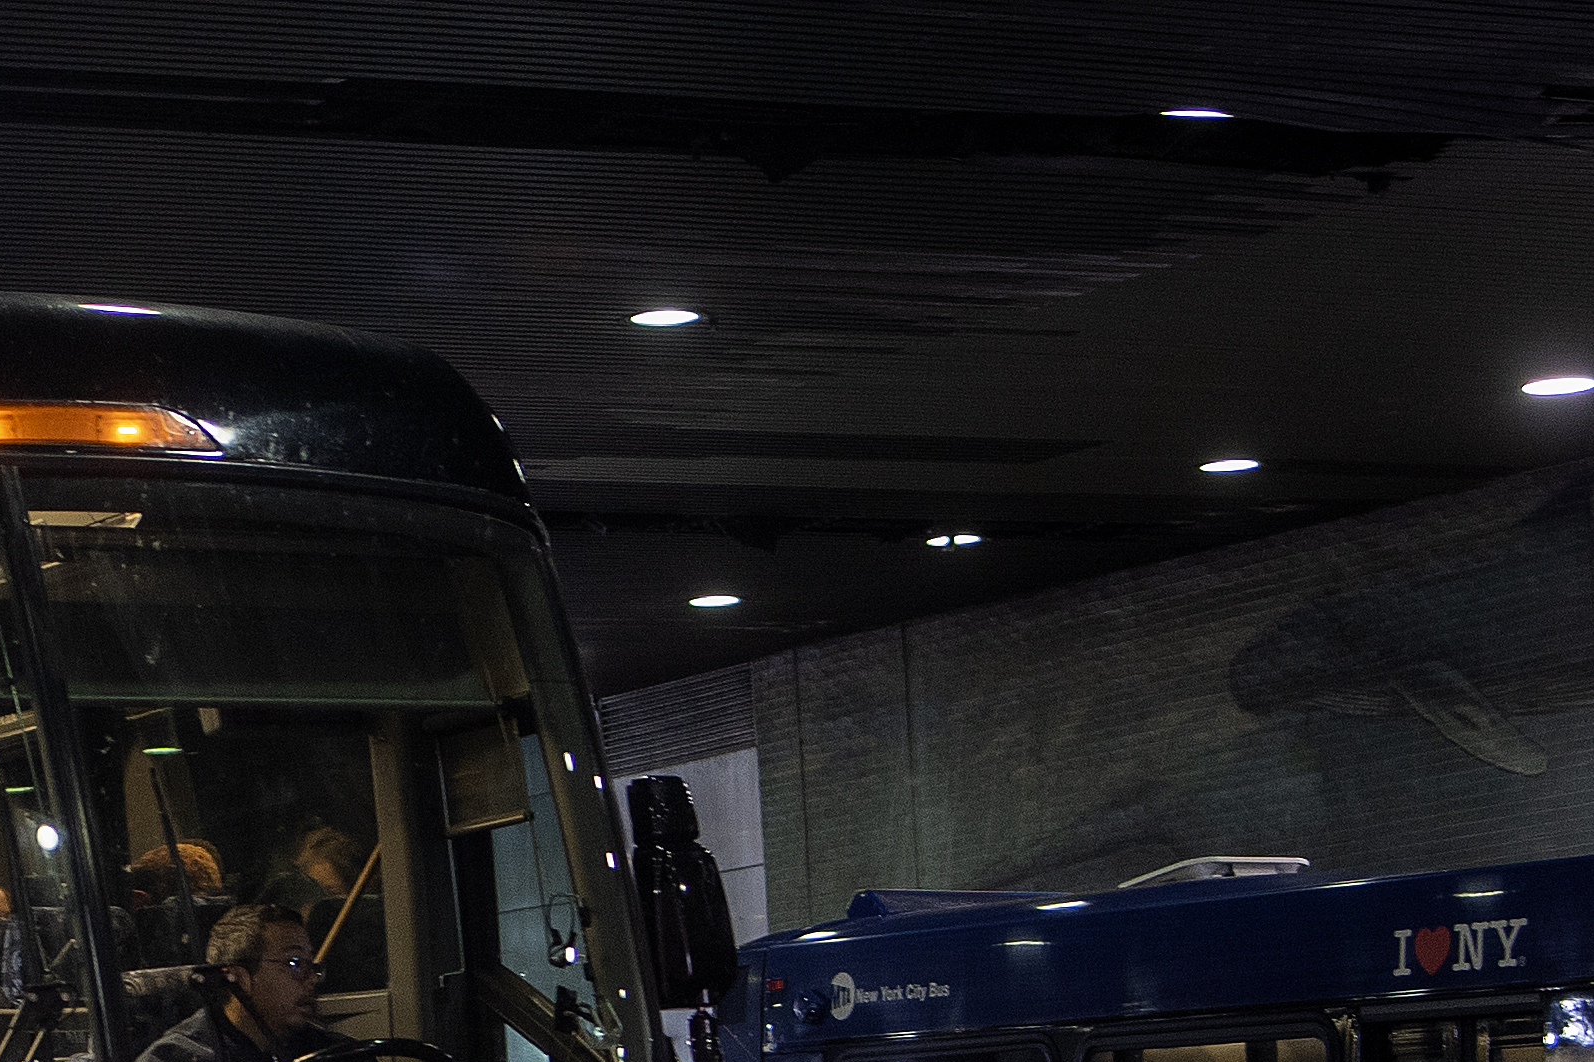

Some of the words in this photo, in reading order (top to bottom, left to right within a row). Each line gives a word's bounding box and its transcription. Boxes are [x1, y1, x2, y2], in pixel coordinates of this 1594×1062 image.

[1392, 929, 1412, 976] I
[1452, 917, 1528, 971] NY
[856, 988, 878, 1003] New
[880, 985, 904, 1001] York
[906, 983, 928, 1001] City
[929, 982, 950, 998] Bus
